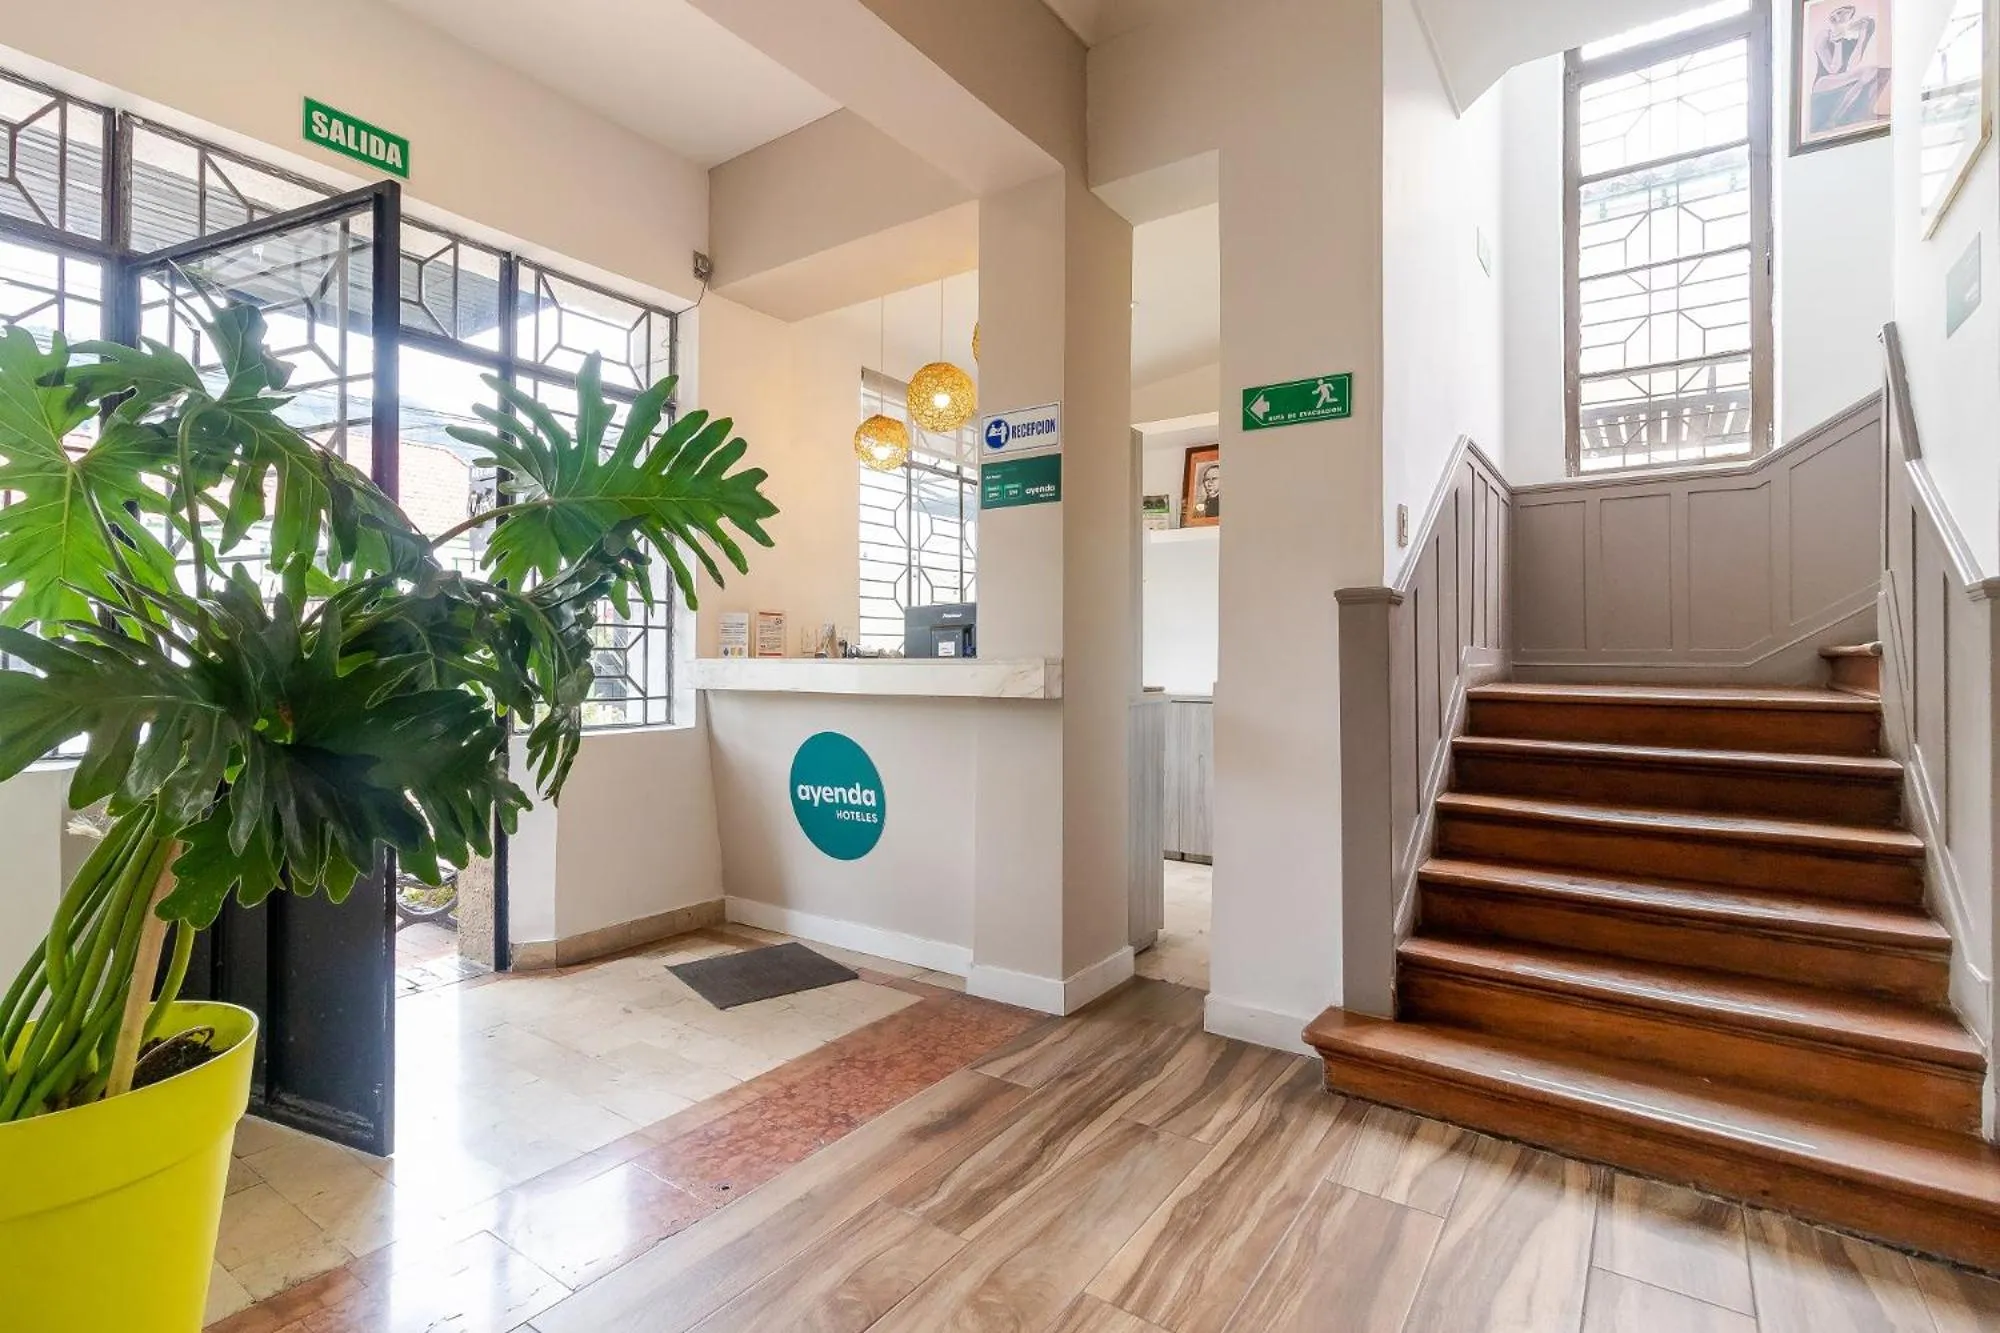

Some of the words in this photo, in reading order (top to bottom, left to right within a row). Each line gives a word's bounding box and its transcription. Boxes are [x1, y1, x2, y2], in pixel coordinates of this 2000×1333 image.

[312, 110, 402, 169] SALIDA
[797, 782, 877, 807] ayenda
[836, 810, 878, 824] HOTELES
